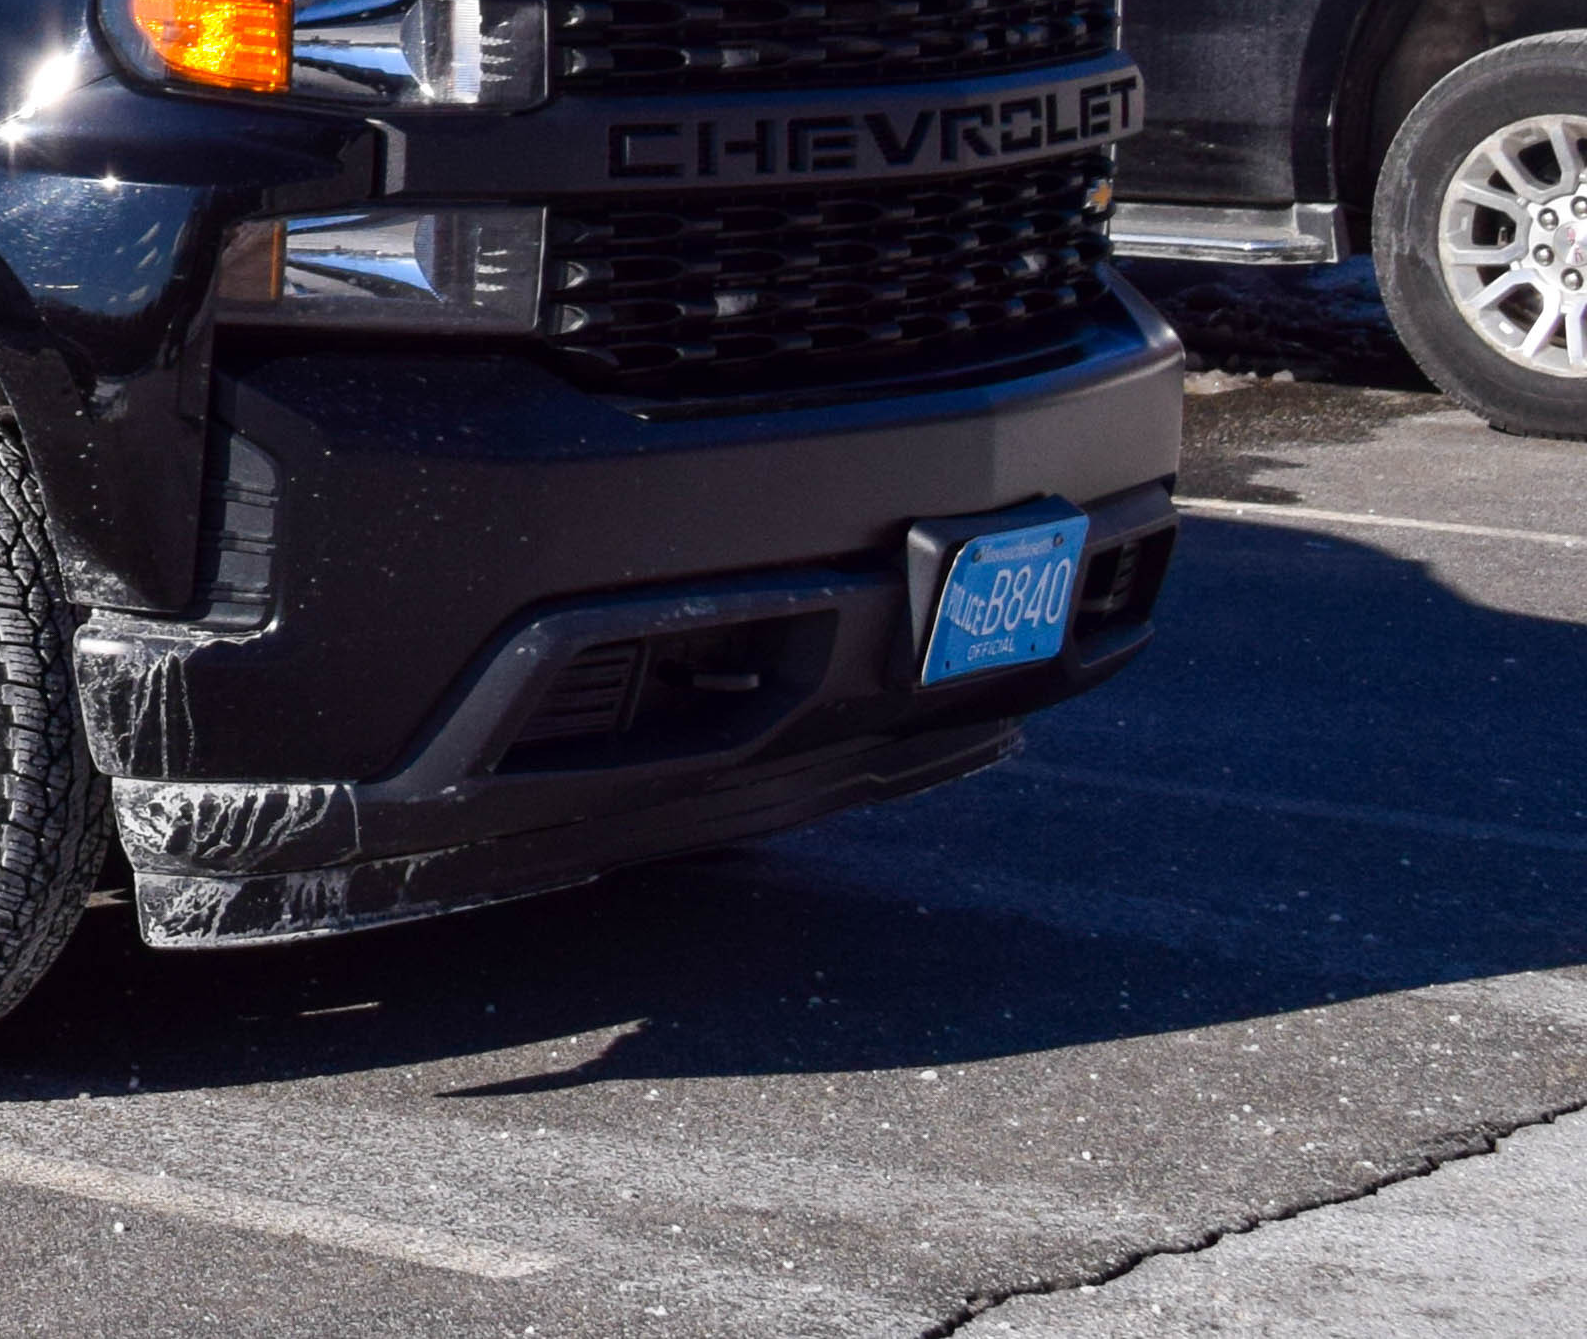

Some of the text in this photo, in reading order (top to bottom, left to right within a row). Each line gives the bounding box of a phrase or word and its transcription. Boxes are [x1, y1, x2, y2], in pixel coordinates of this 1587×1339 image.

[609, 76, 1137, 178] CHEVROLET
[946, 557, 1071, 636] POLICE B840
[967, 638, 1015, 661] OFFICIAL
